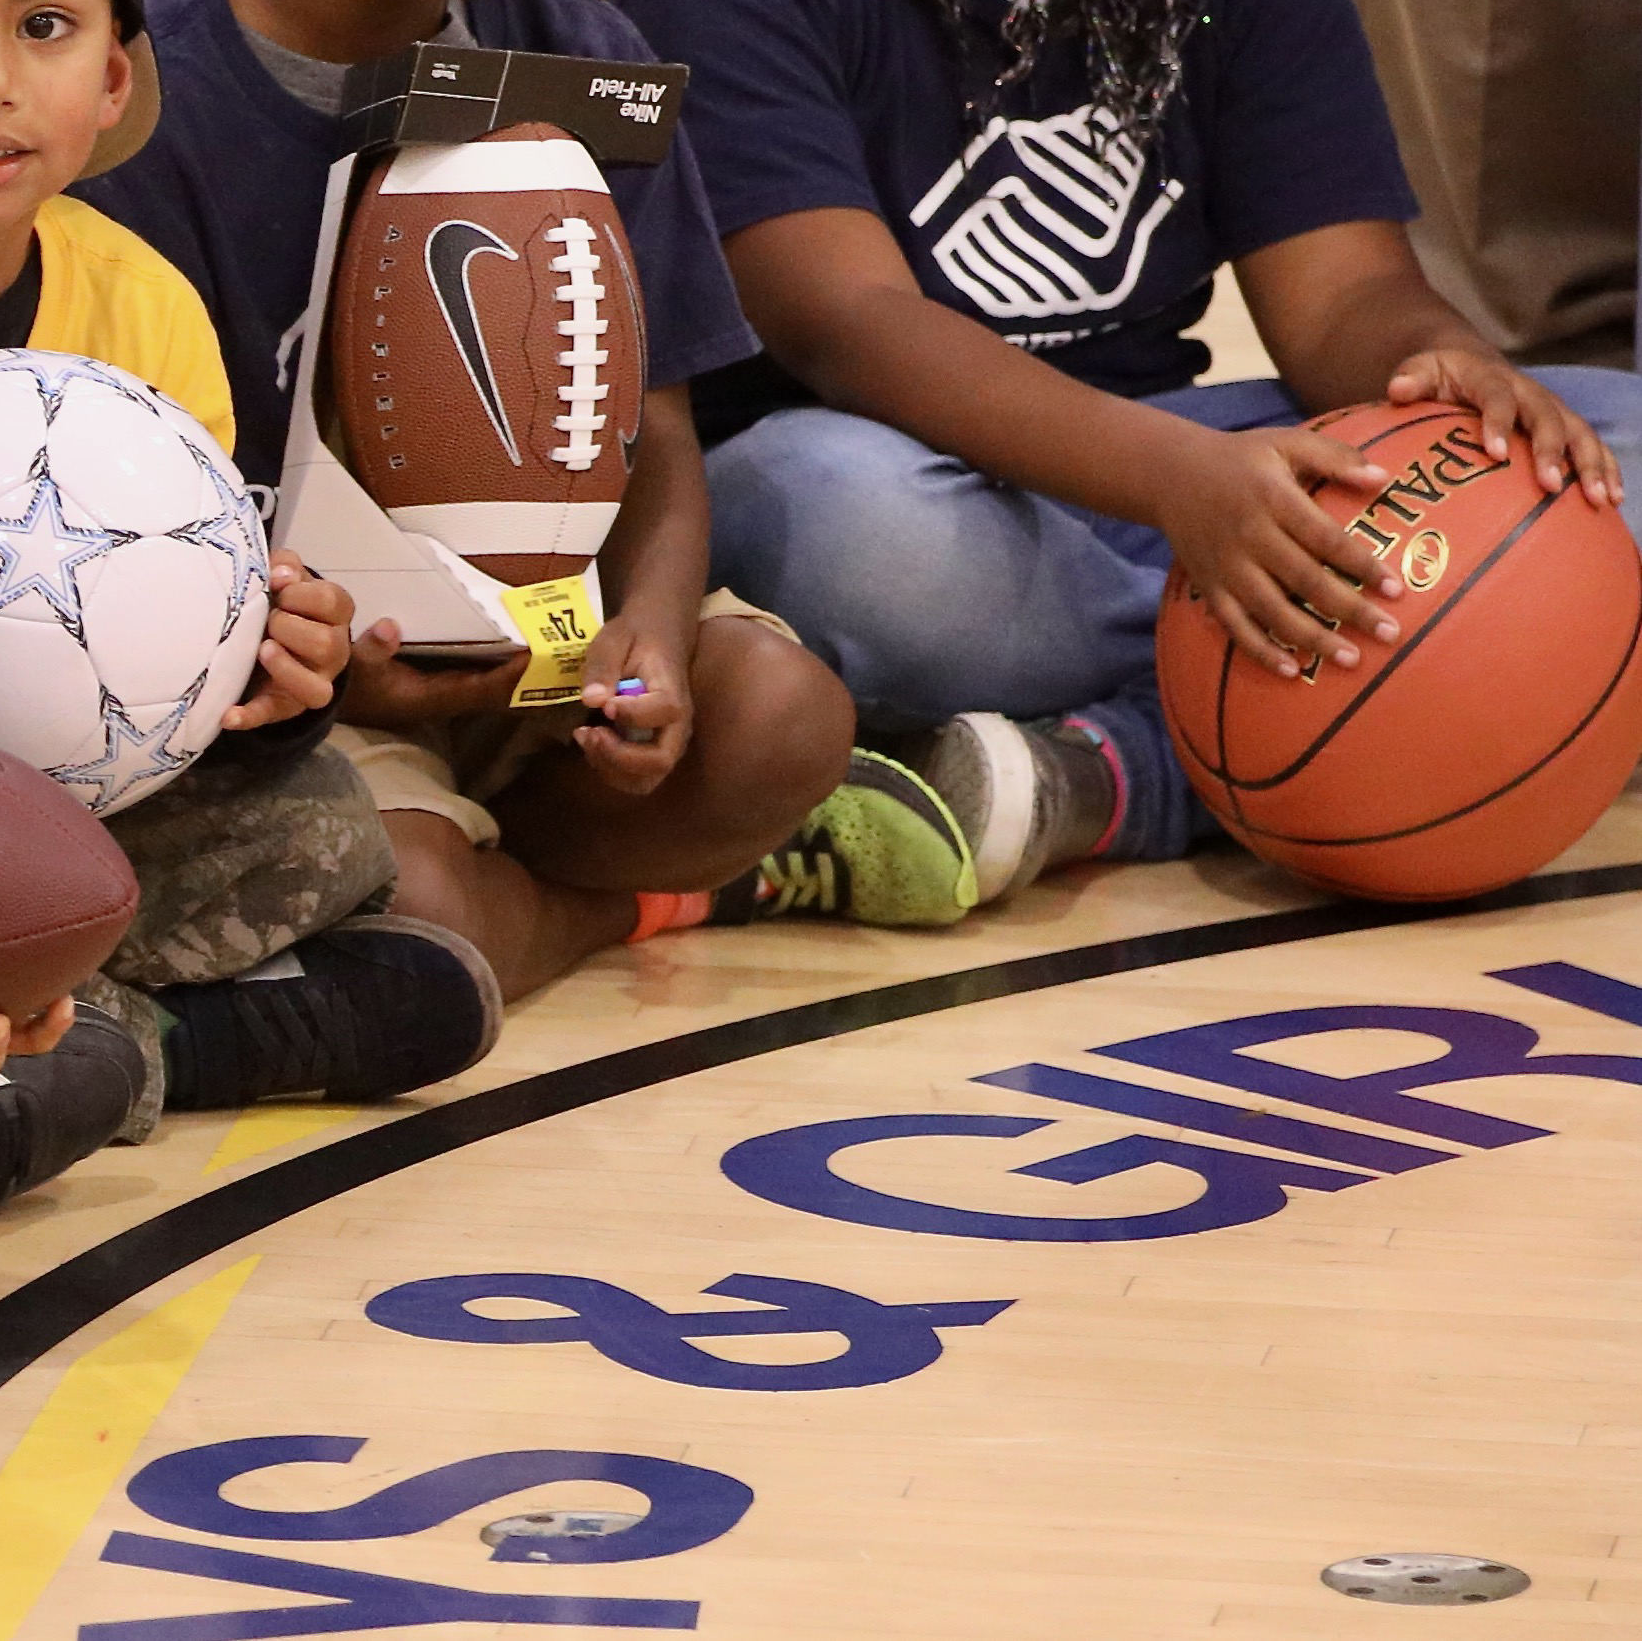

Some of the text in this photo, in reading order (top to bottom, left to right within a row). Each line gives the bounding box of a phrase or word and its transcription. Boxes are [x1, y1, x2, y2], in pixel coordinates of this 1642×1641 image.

[589, 77, 667, 103] All-Field
[620, 102, 661, 124] Nike
[364, 1271, 1020, 1393] &
